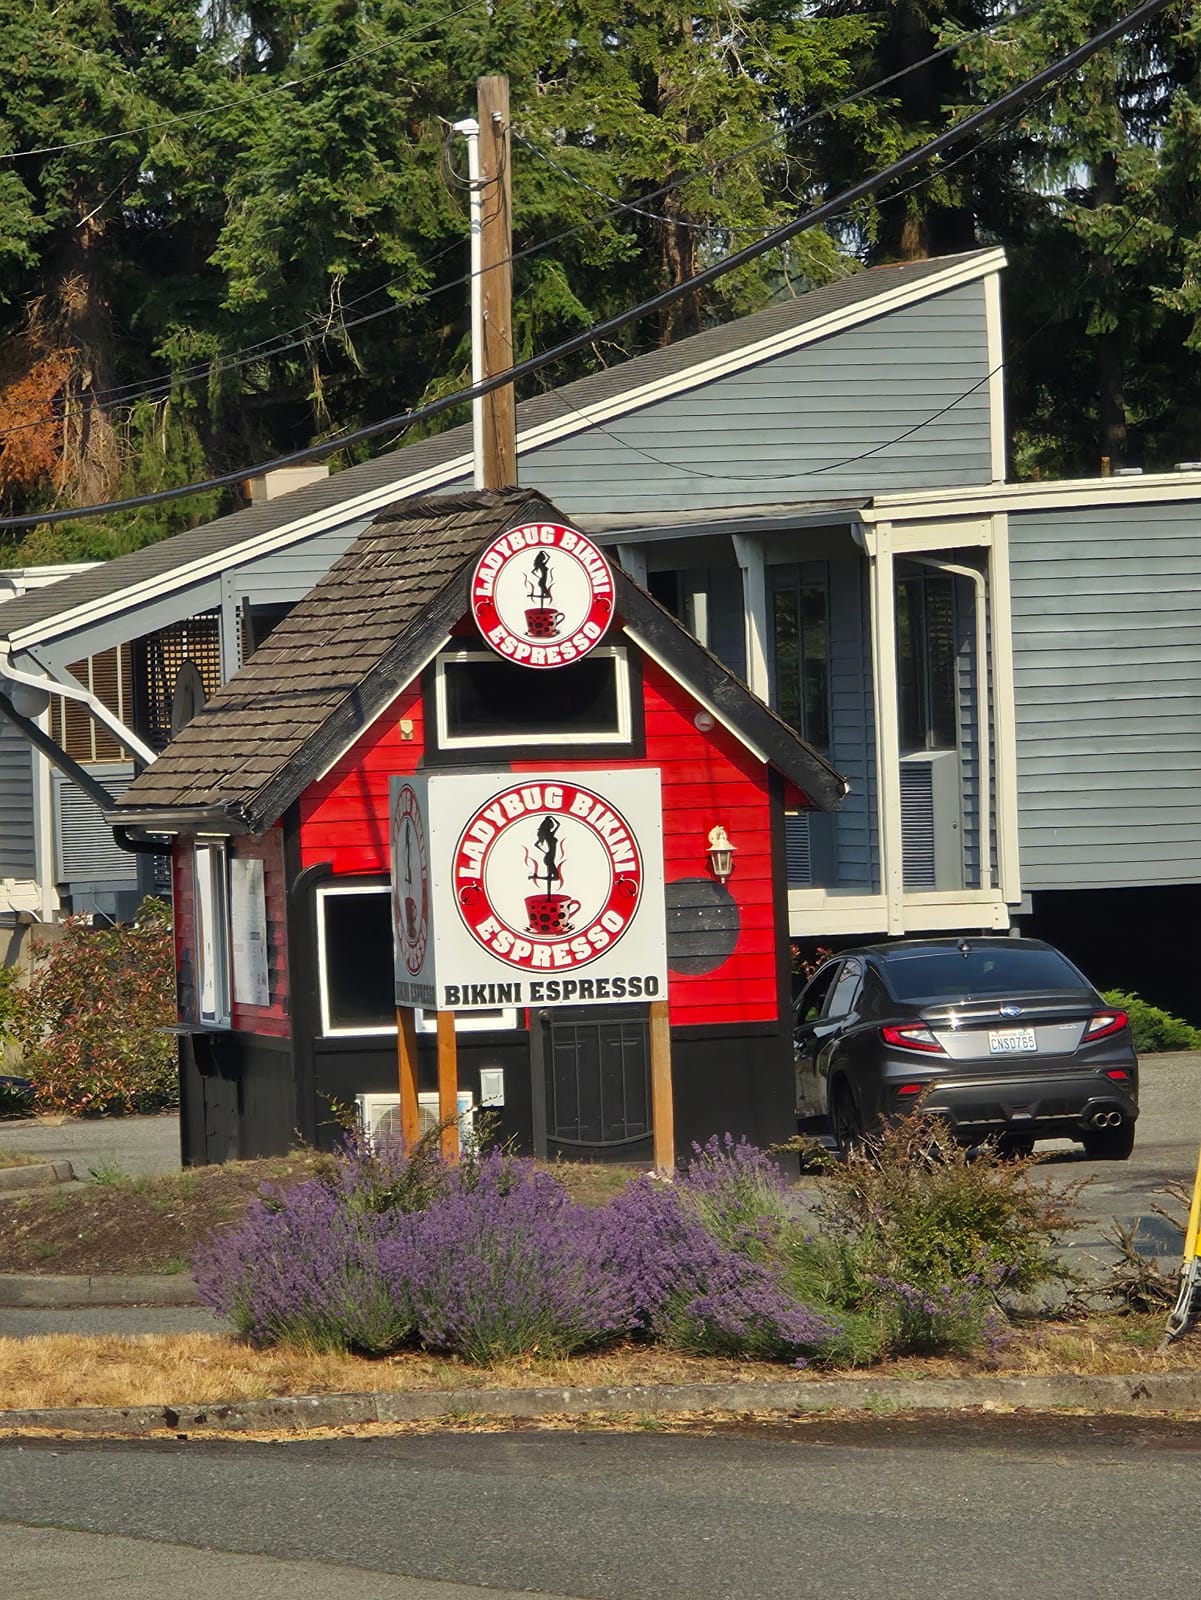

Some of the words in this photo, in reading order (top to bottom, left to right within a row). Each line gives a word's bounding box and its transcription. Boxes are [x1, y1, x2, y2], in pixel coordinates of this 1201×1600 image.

[475, 526, 556, 597] LADYBUG
[559, 530, 611, 595] BIKINI
[487, 620, 601, 665] ESPRESSO
[458, 785, 564, 880] LADYBUG
[569, 791, 636, 873] BIKINI
[475, 909, 624, 968] ESPRESSO
[444, 982, 522, 1006] BIKINI
[529, 975, 659, 1002] ESPRESSO
[991, 1035, 1035, 1050] CNS0765
